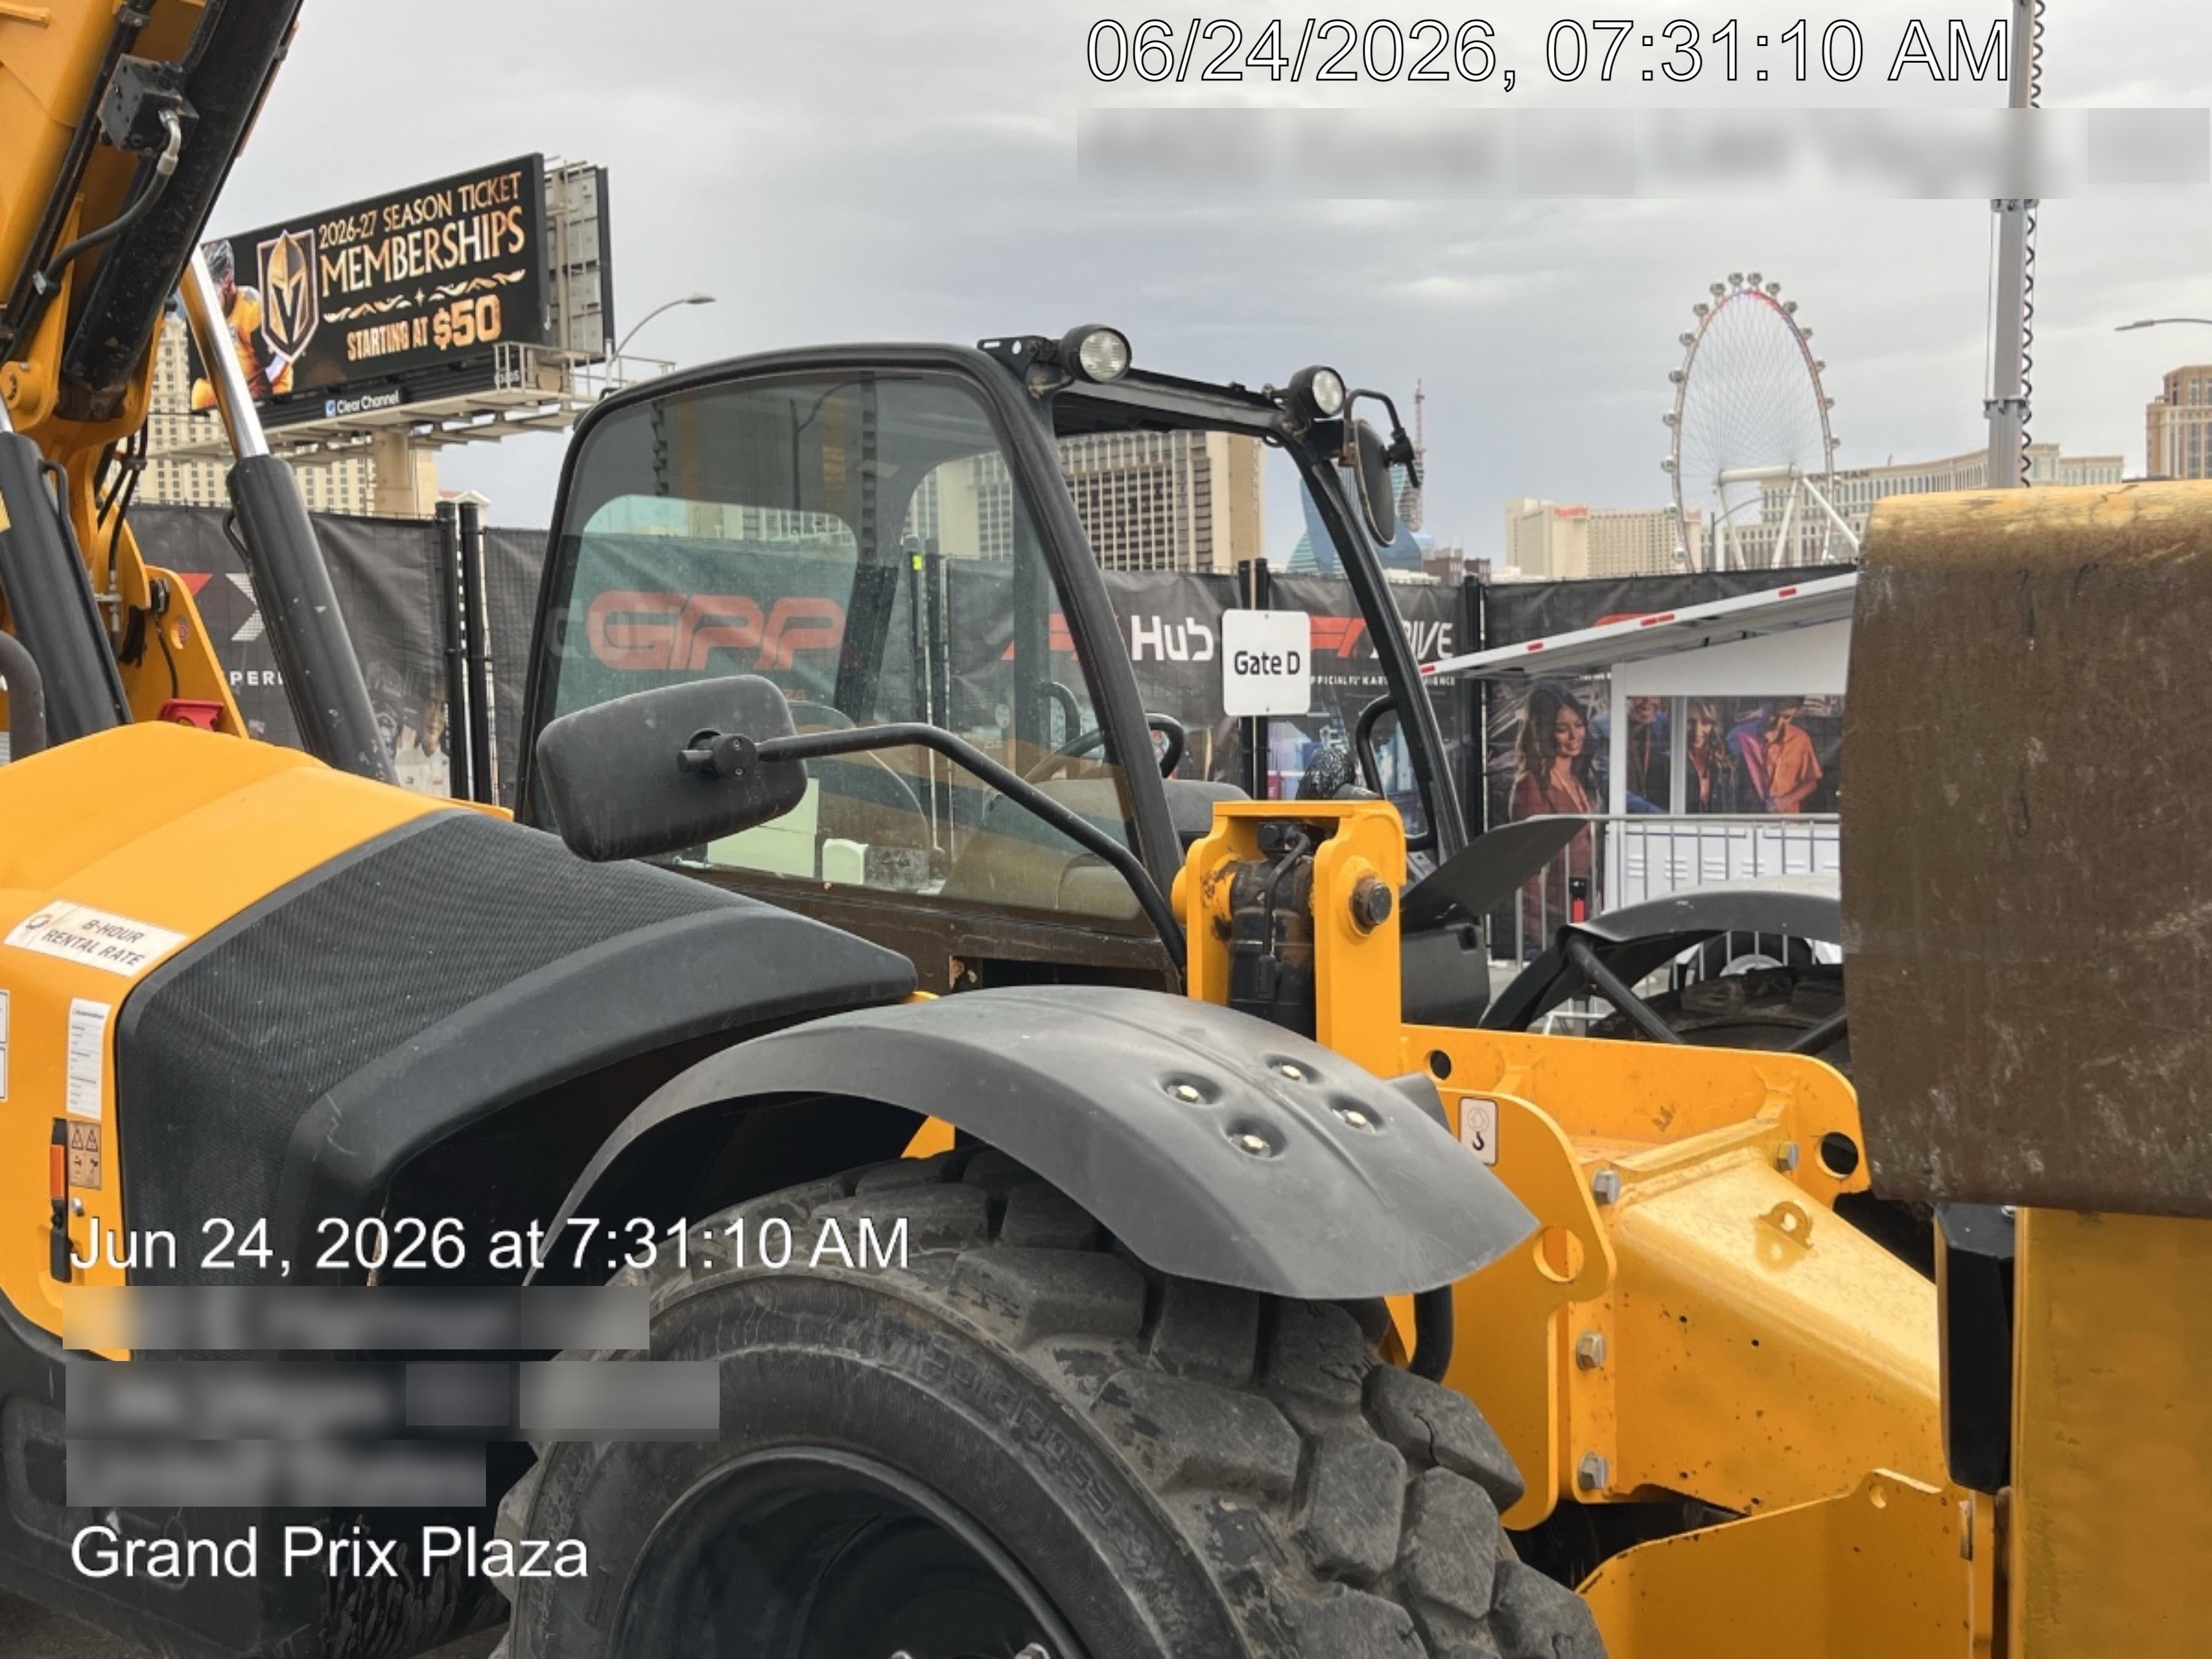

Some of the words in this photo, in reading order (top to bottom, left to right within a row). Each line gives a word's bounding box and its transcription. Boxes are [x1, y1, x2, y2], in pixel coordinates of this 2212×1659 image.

[318, 210, 378, 249] 2026-27
[383, 189, 453, 232] SEASON
[458, 172, 521, 213] TICKET
[320, 205, 526, 298] MEMBERSHIPS
[347, 320, 410, 361] STARTING
[413, 316, 429, 348] AT
[433, 294, 502, 351] $50
[337, 399, 361, 414] Clear
[361, 390, 399, 410] Channel
[1131, 615, 1214, 661] Hub
[1234, 650, 1282, 675] Gate
[1287, 650, 1301, 675] D
[42, 928, 100, 954] RENTAL
[97, 944, 146, 966] RATE
